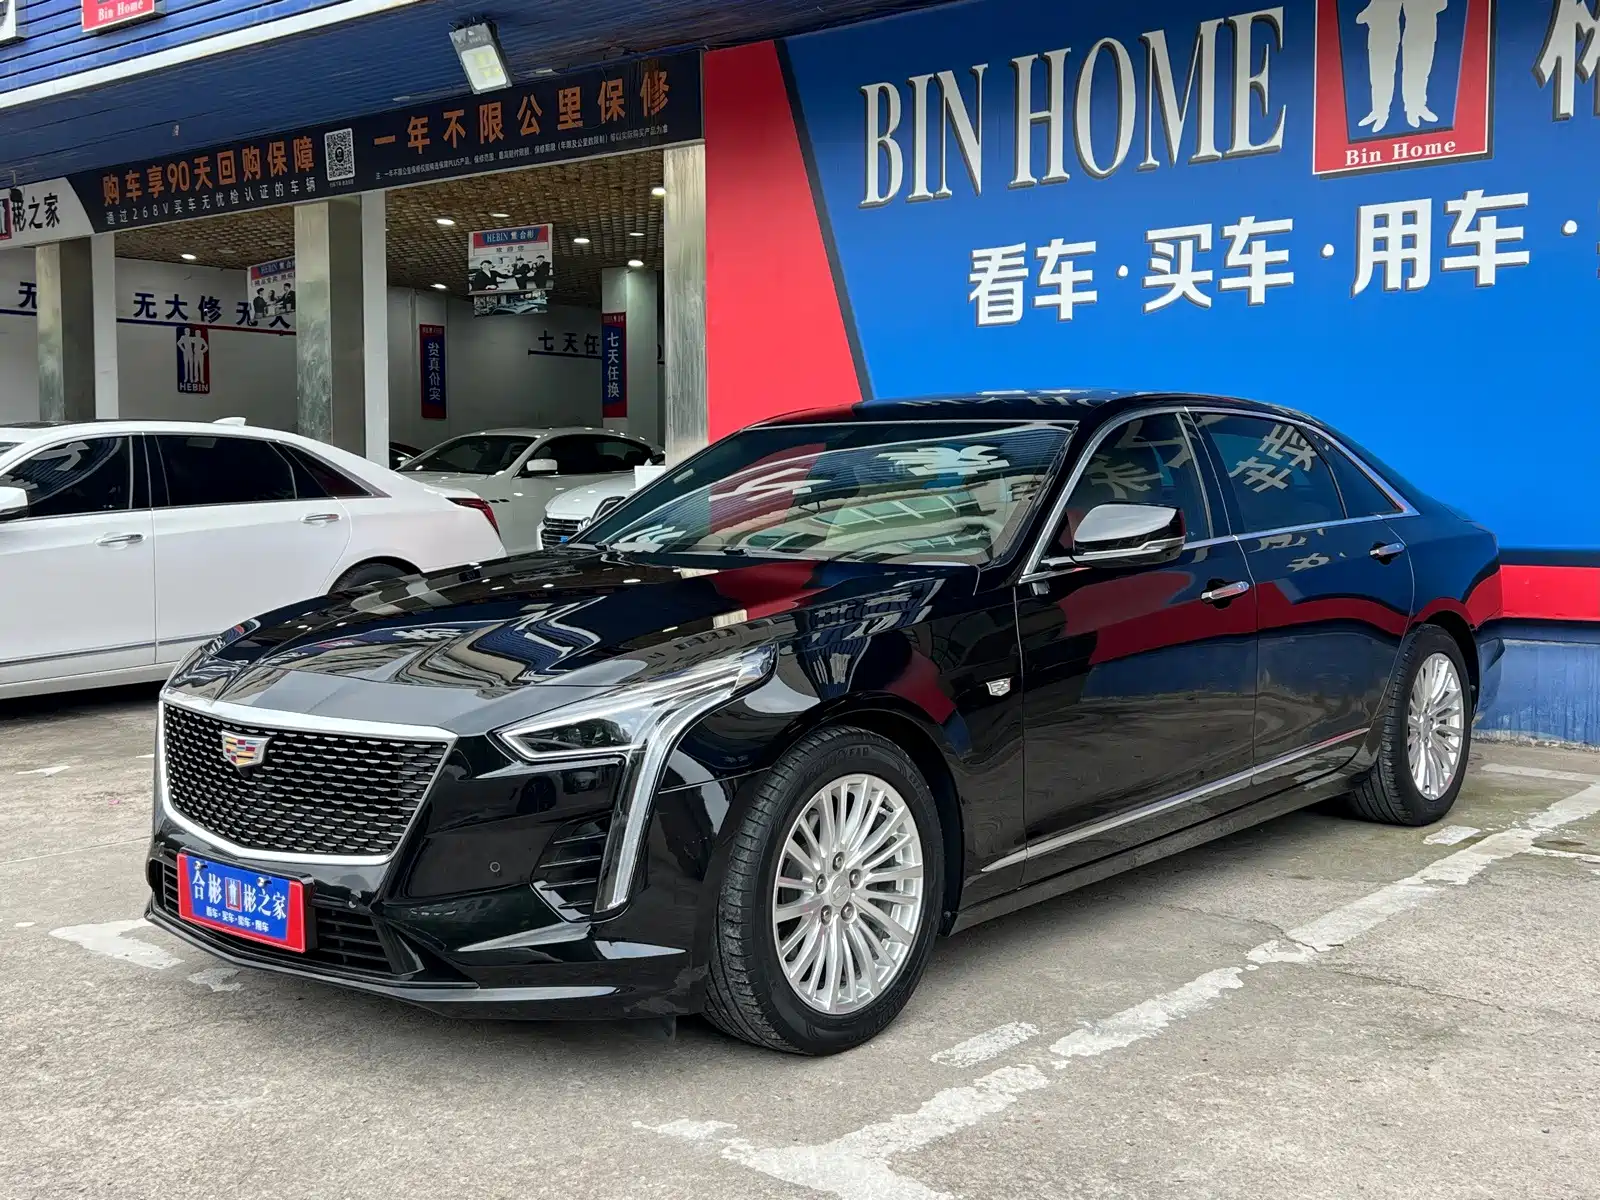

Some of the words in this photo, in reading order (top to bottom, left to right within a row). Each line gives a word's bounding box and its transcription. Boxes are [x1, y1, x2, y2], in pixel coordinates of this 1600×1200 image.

[98, 6, 114, 20] Bin
[117, 0, 144, 16] Home
[374, 71, 671, 155] 一年不限公里保修
[859, 64, 989, 208] BIN
[1008, 6, 1286, 190] HOME
[102, 136, 315, 207] 购车享90天回购保障
[1345, 148, 1382, 167] Bin
[1392, 139, 1457, 161] Home
[180, 382, 209, 392] HEBIN
[607, 331, 620, 398] 七天任换
